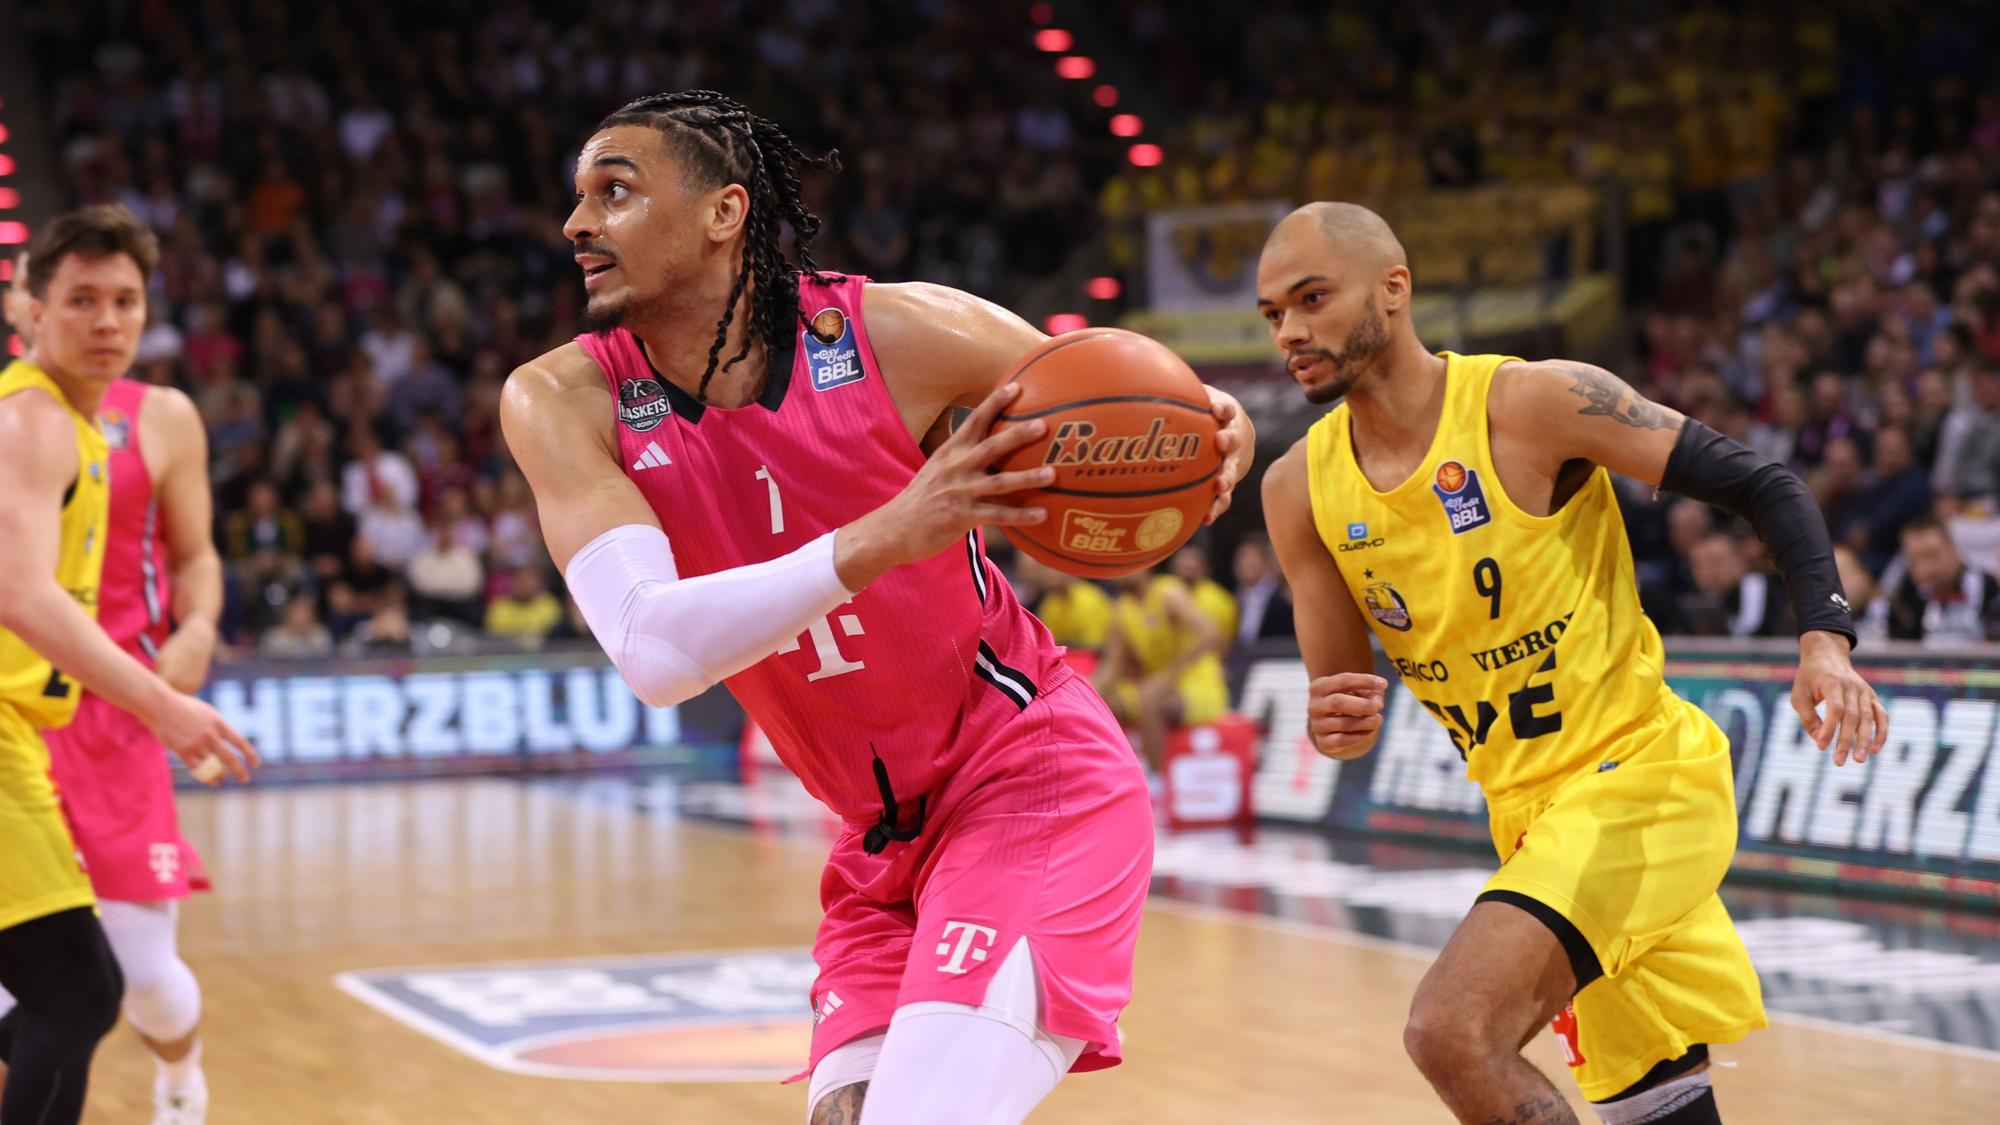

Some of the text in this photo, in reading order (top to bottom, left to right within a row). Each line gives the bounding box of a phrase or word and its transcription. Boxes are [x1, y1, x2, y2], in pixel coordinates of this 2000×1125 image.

[817, 359, 859, 384] BBL
[1043, 417, 1200, 466] Baden
[1074, 464, 1178, 477] PERFECTION
[755, 464, 785, 535] 1
[1451, 506, 1485, 529] BBL
[1071, 533, 1122, 552] BBL
[1473, 557, 1502, 621] 9
[1470, 611, 1574, 672] VIERO
